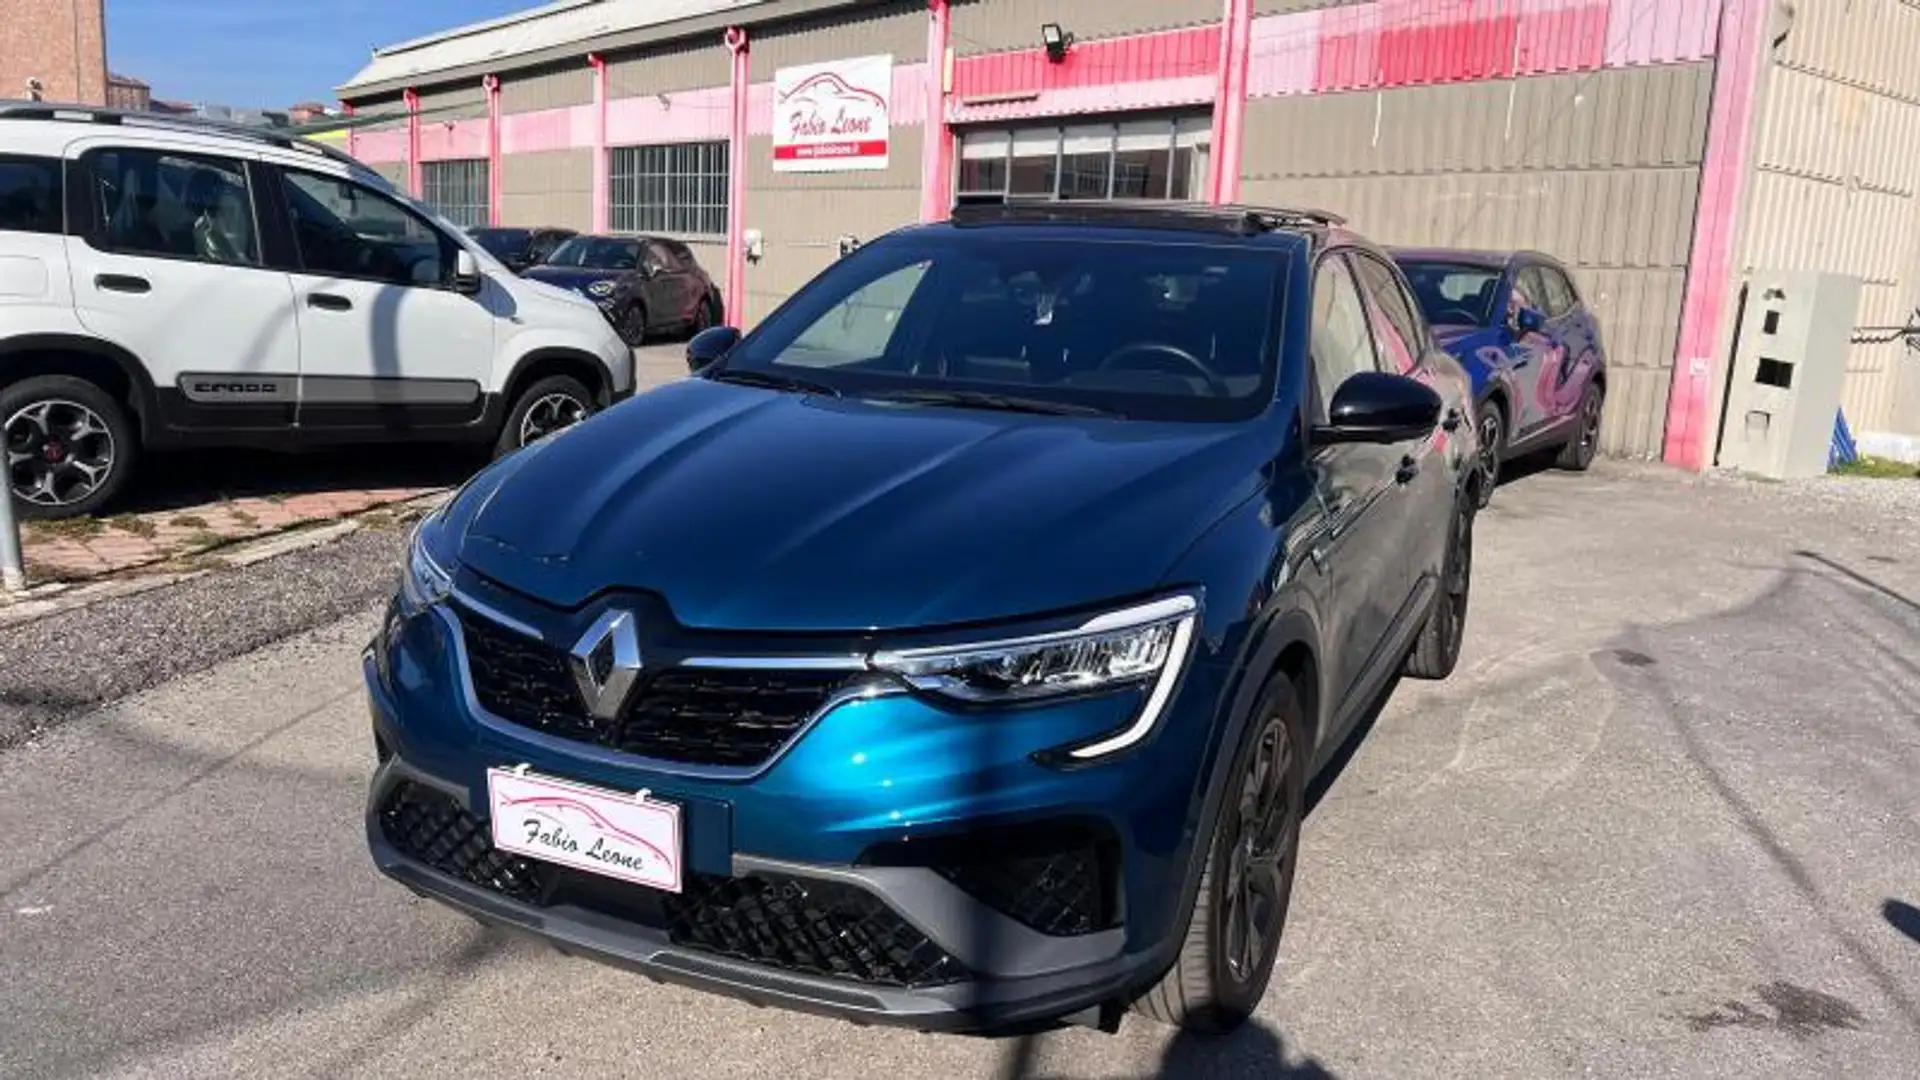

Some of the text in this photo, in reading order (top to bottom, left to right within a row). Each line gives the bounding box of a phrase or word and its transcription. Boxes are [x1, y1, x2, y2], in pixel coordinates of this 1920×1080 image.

[789, 105, 872, 142] Fabio Leone
[523, 818, 644, 871] Fabio Leone
